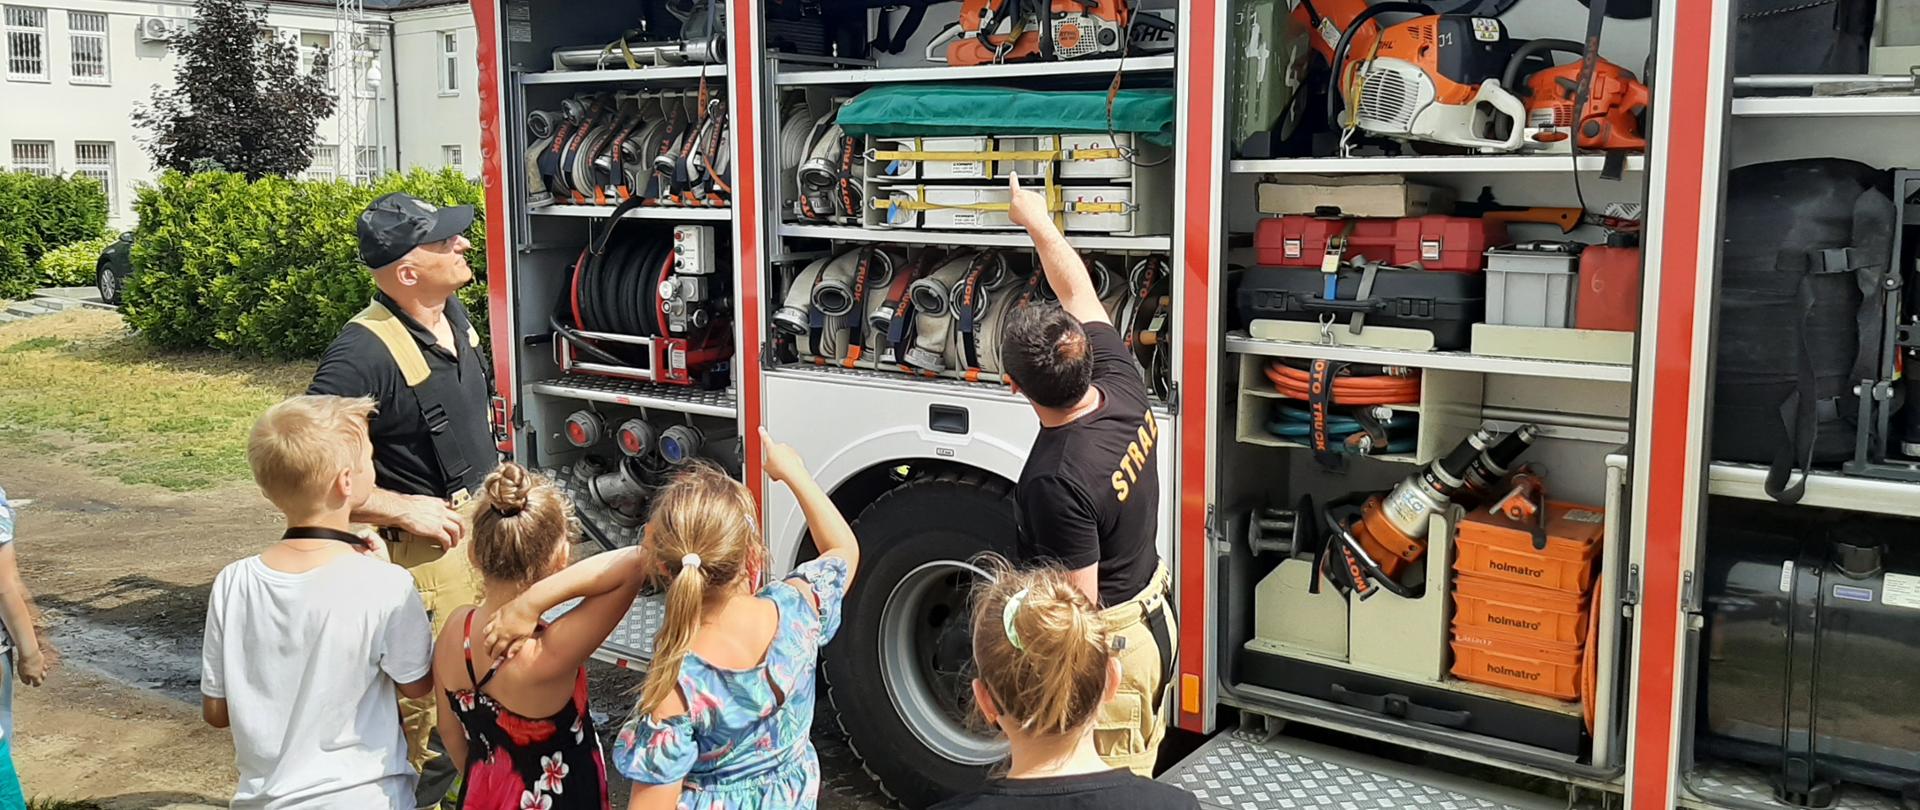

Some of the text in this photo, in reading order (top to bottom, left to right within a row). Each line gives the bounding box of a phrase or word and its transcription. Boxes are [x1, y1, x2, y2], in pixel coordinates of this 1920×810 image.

[842, 136, 855, 171] TRUC
[854, 260, 867, 303] TRUCK
[1311, 360, 1326, 451] OTO TRUCK
